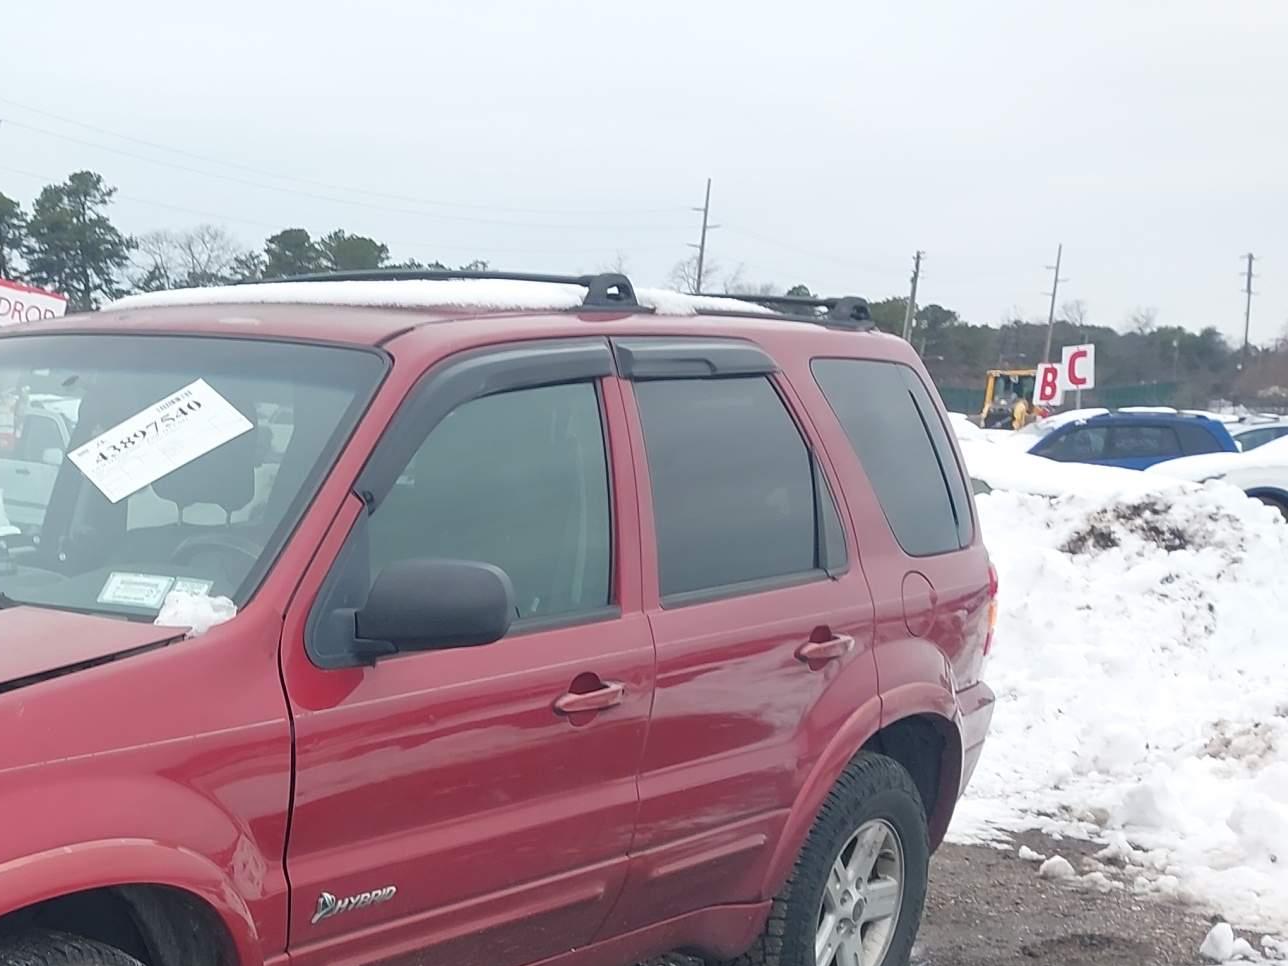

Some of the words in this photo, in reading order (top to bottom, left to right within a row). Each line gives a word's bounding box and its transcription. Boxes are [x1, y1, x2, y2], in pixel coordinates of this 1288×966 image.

[1039, 367, 1058, 401] B
[1068, 350, 1087, 385] C
[96, 400, 202, 464] 43897540
[334, 885, 397, 913] HYBRID
